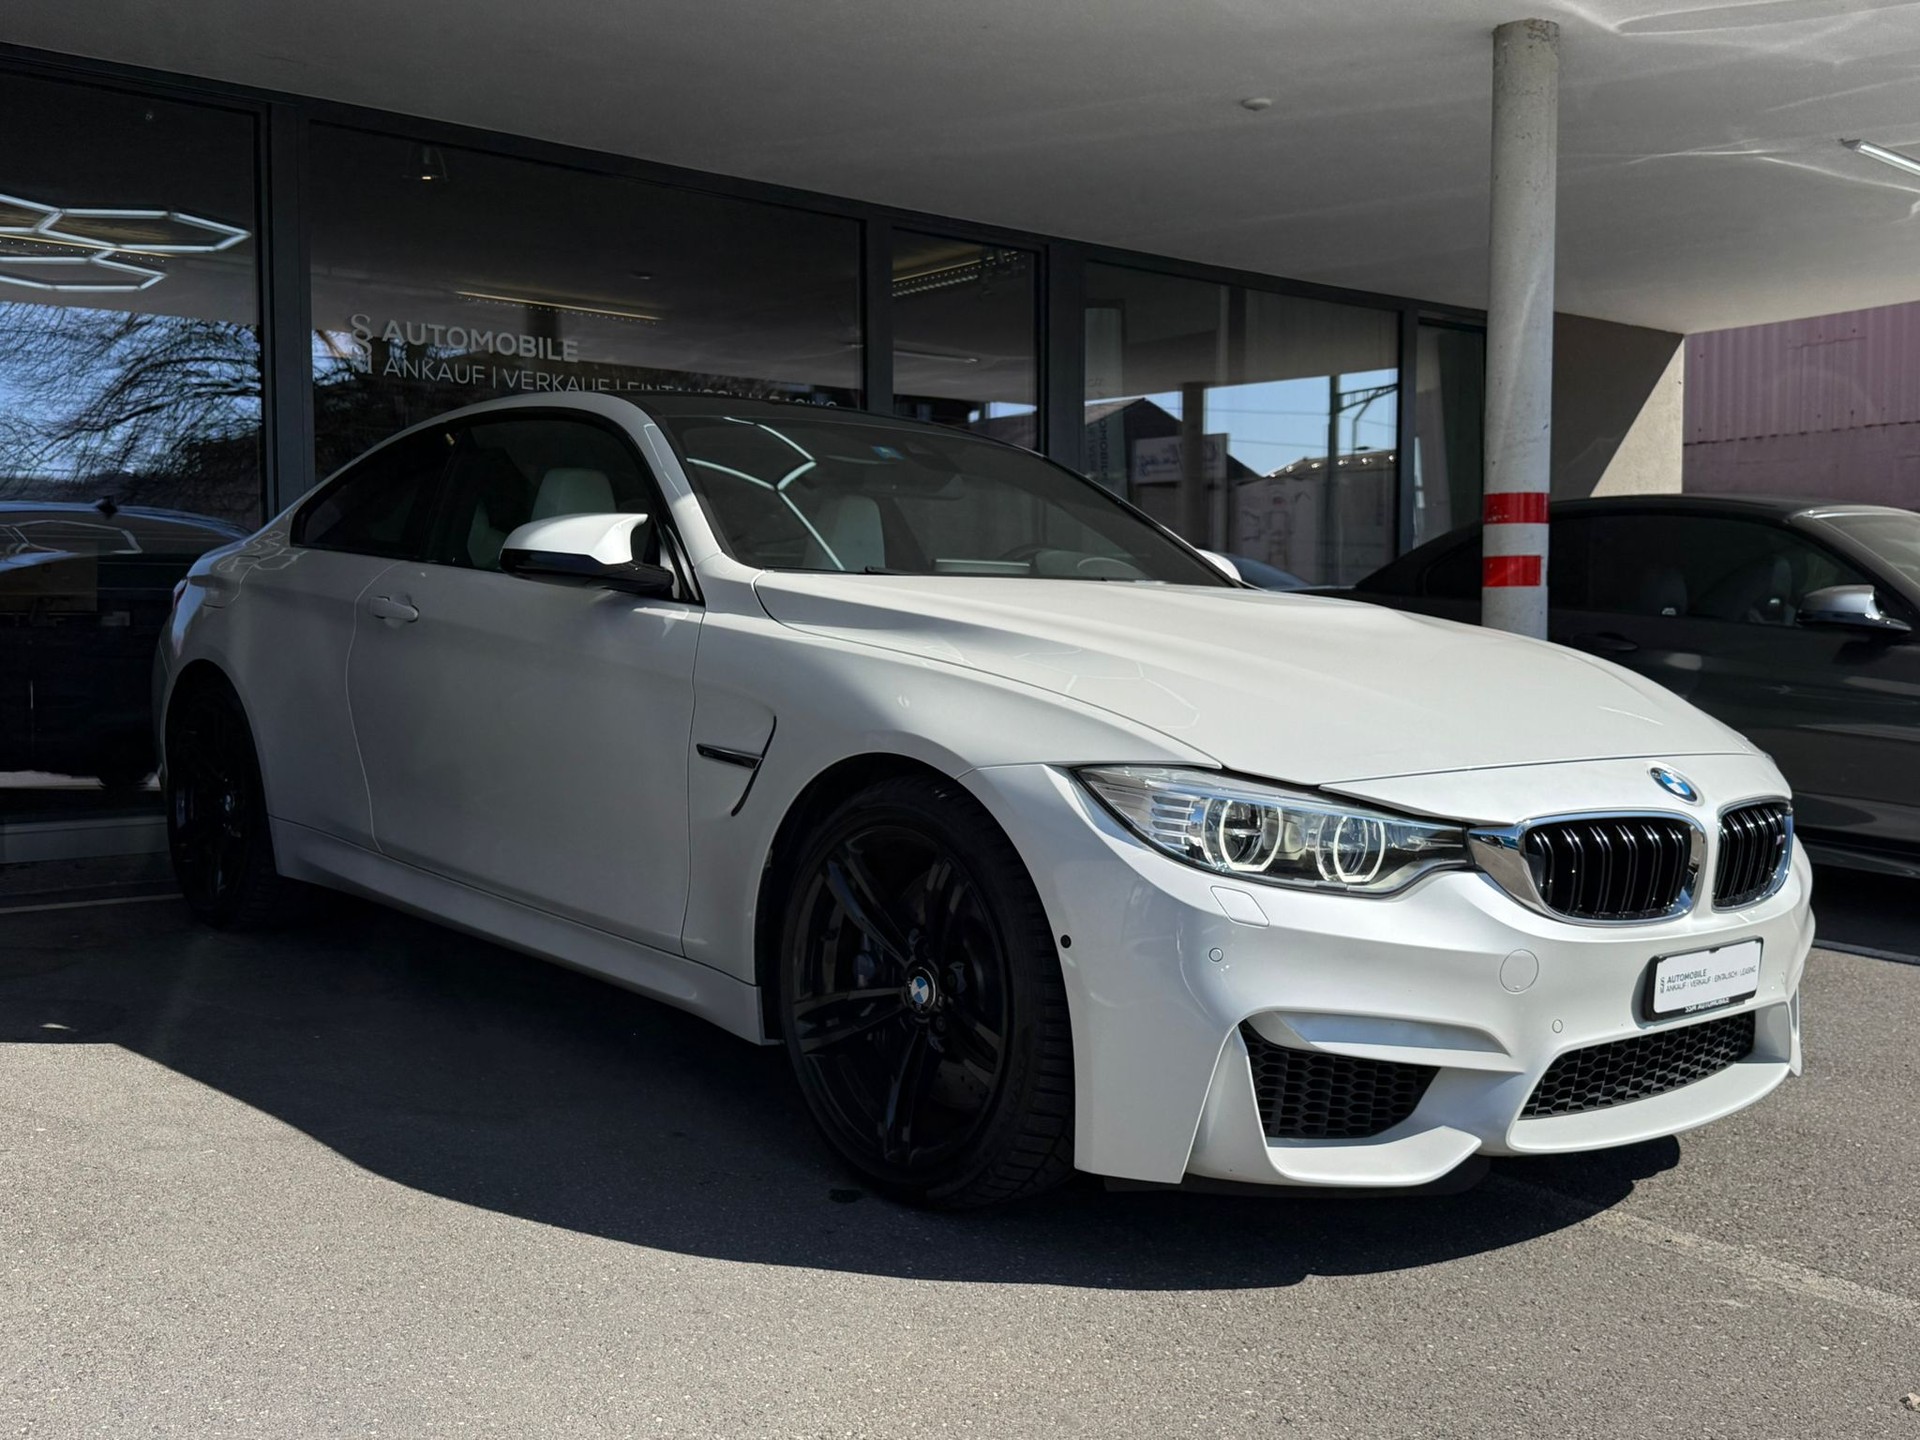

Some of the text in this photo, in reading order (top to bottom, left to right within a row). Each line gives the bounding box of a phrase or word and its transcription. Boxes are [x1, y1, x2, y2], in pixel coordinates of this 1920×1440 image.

[382, 320, 580, 362] AUTOMOBILE
[382, 357, 486, 386] ANKAUF
[1667, 969, 1707, 983] AUTOMOBILE
